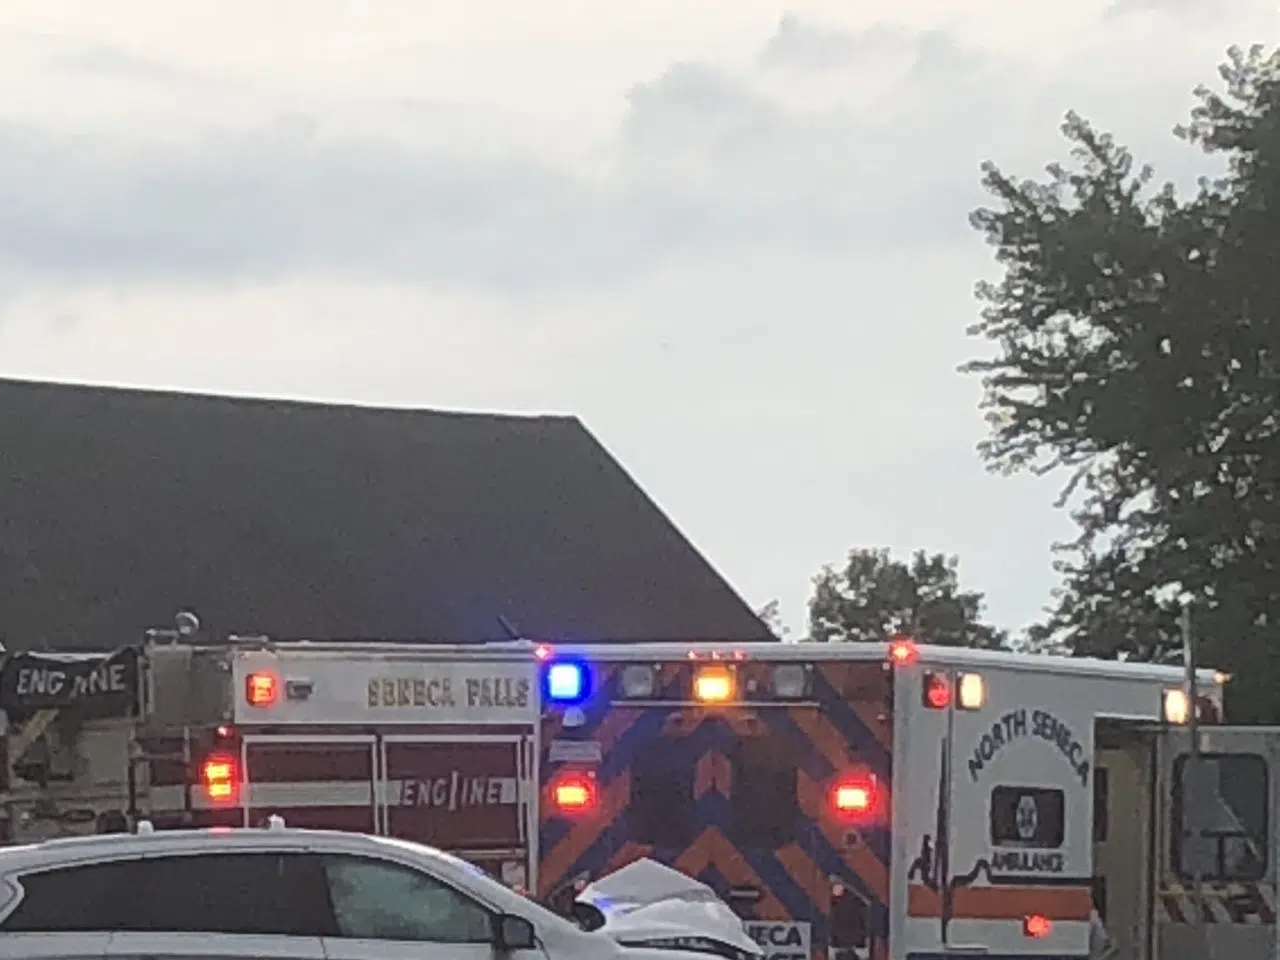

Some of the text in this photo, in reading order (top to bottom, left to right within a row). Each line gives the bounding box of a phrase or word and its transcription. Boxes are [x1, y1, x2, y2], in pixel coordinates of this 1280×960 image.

[367, 677, 530, 708] SENECA FALLS
[968, 708, 1090, 788] NORTH SENECA
